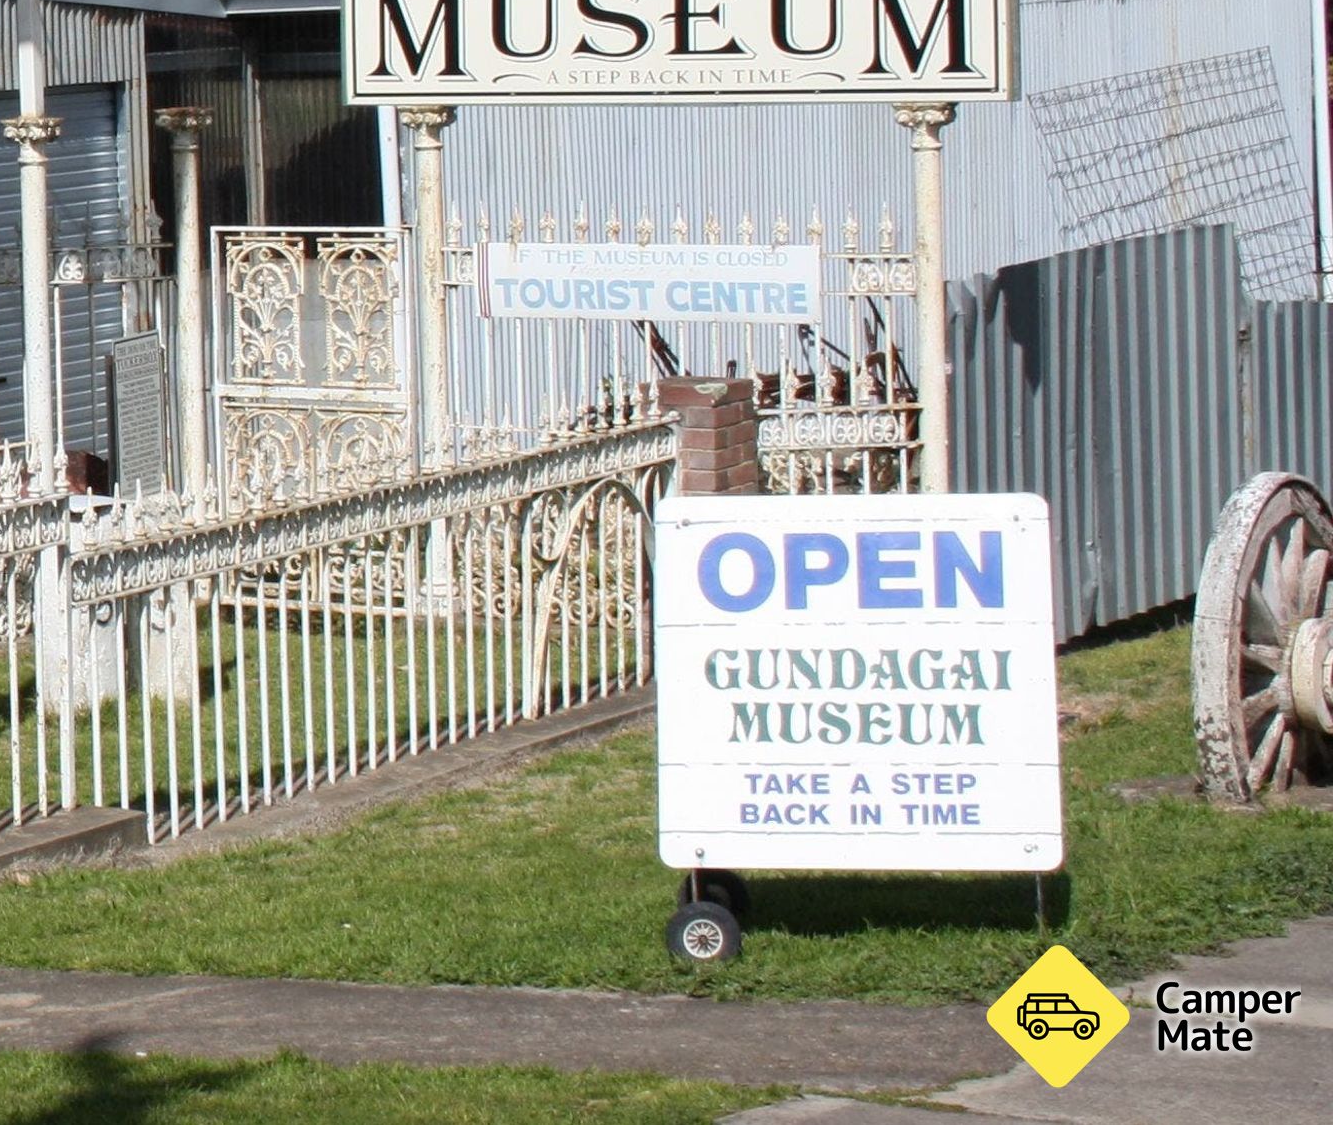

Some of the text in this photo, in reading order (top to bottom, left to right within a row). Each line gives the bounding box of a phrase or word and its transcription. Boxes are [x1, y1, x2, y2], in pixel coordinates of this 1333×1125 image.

[547, 69, 793, 84] A STEP BACK IN TIME
[543, 249, 584, 265] THE
[593, 250, 685, 266] MUSEUM
[693, 252, 709, 266] IS
[715, 252, 789, 267] CLOSED
[494, 278, 808, 315] TOURIST CENTRE
[697, 530, 1004, 612] OPEN
[704, 648, 1012, 690] GUNDAGAI
[728, 702, 985, 746] MUSEUM
[744, 773, 977, 795] TAKE A STEP
[739, 803, 981, 825] BACK IN TIME
